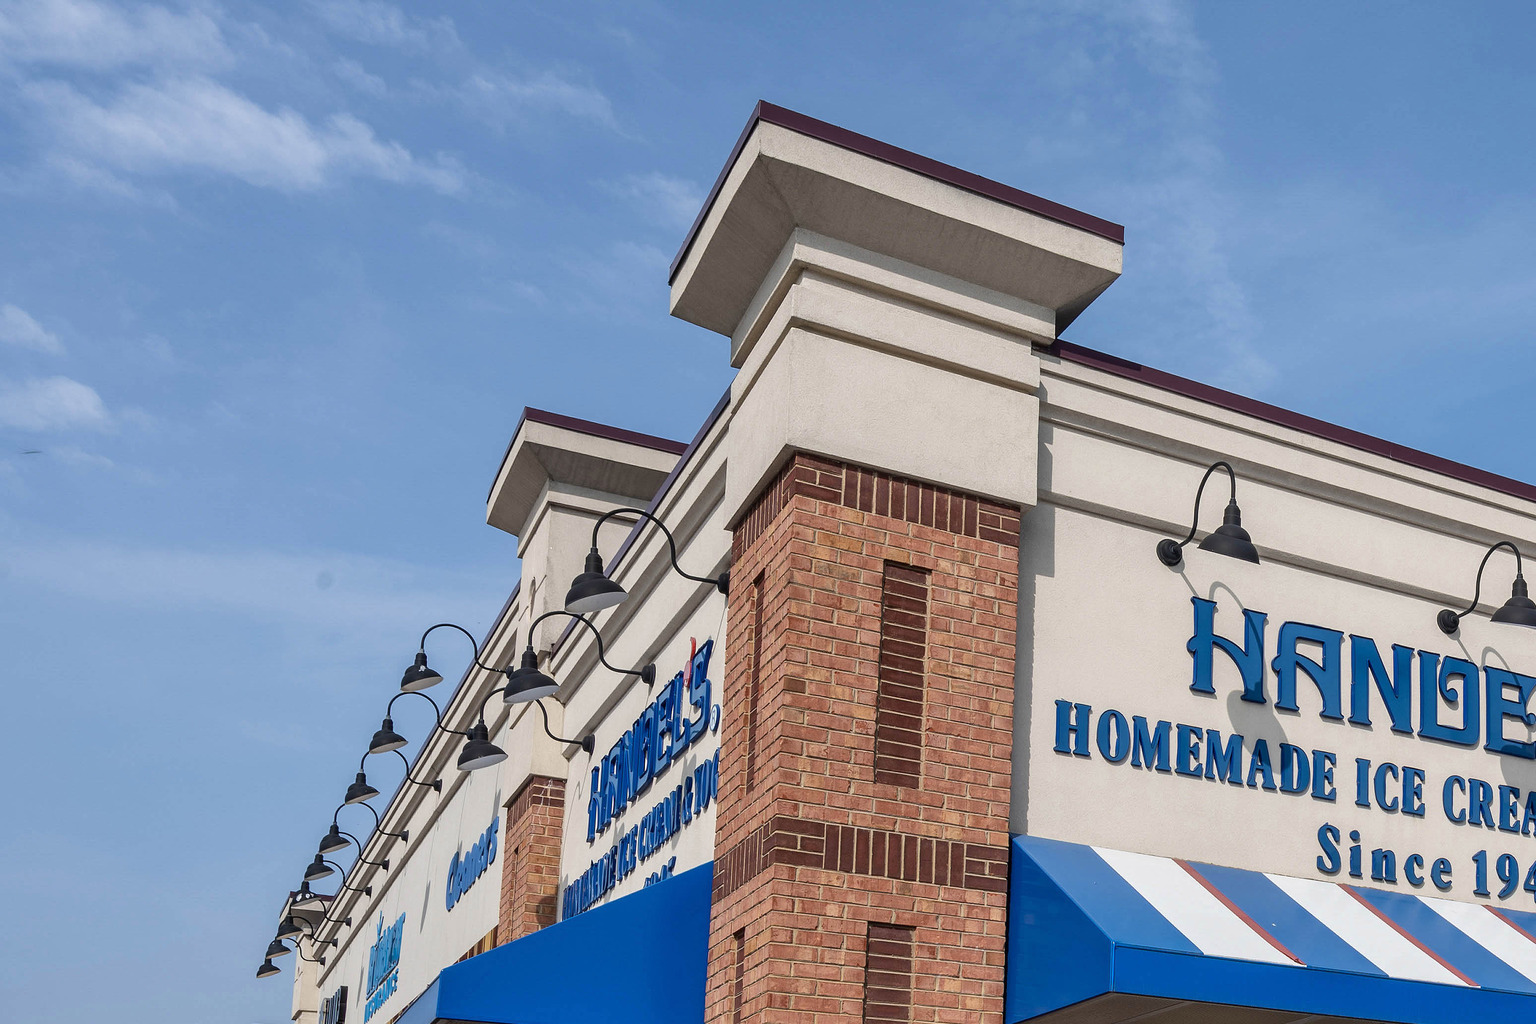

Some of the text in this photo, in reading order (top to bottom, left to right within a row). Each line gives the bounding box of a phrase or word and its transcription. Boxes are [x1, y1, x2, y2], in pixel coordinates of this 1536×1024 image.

[587, 637, 714, 843] HANDEL'S
[694, 746, 720, 815] YOG
[1054, 699, 1338, 802] HOMEMADE
[1355, 758, 1426, 817] ICE
[1316, 822, 1452, 891] Since
